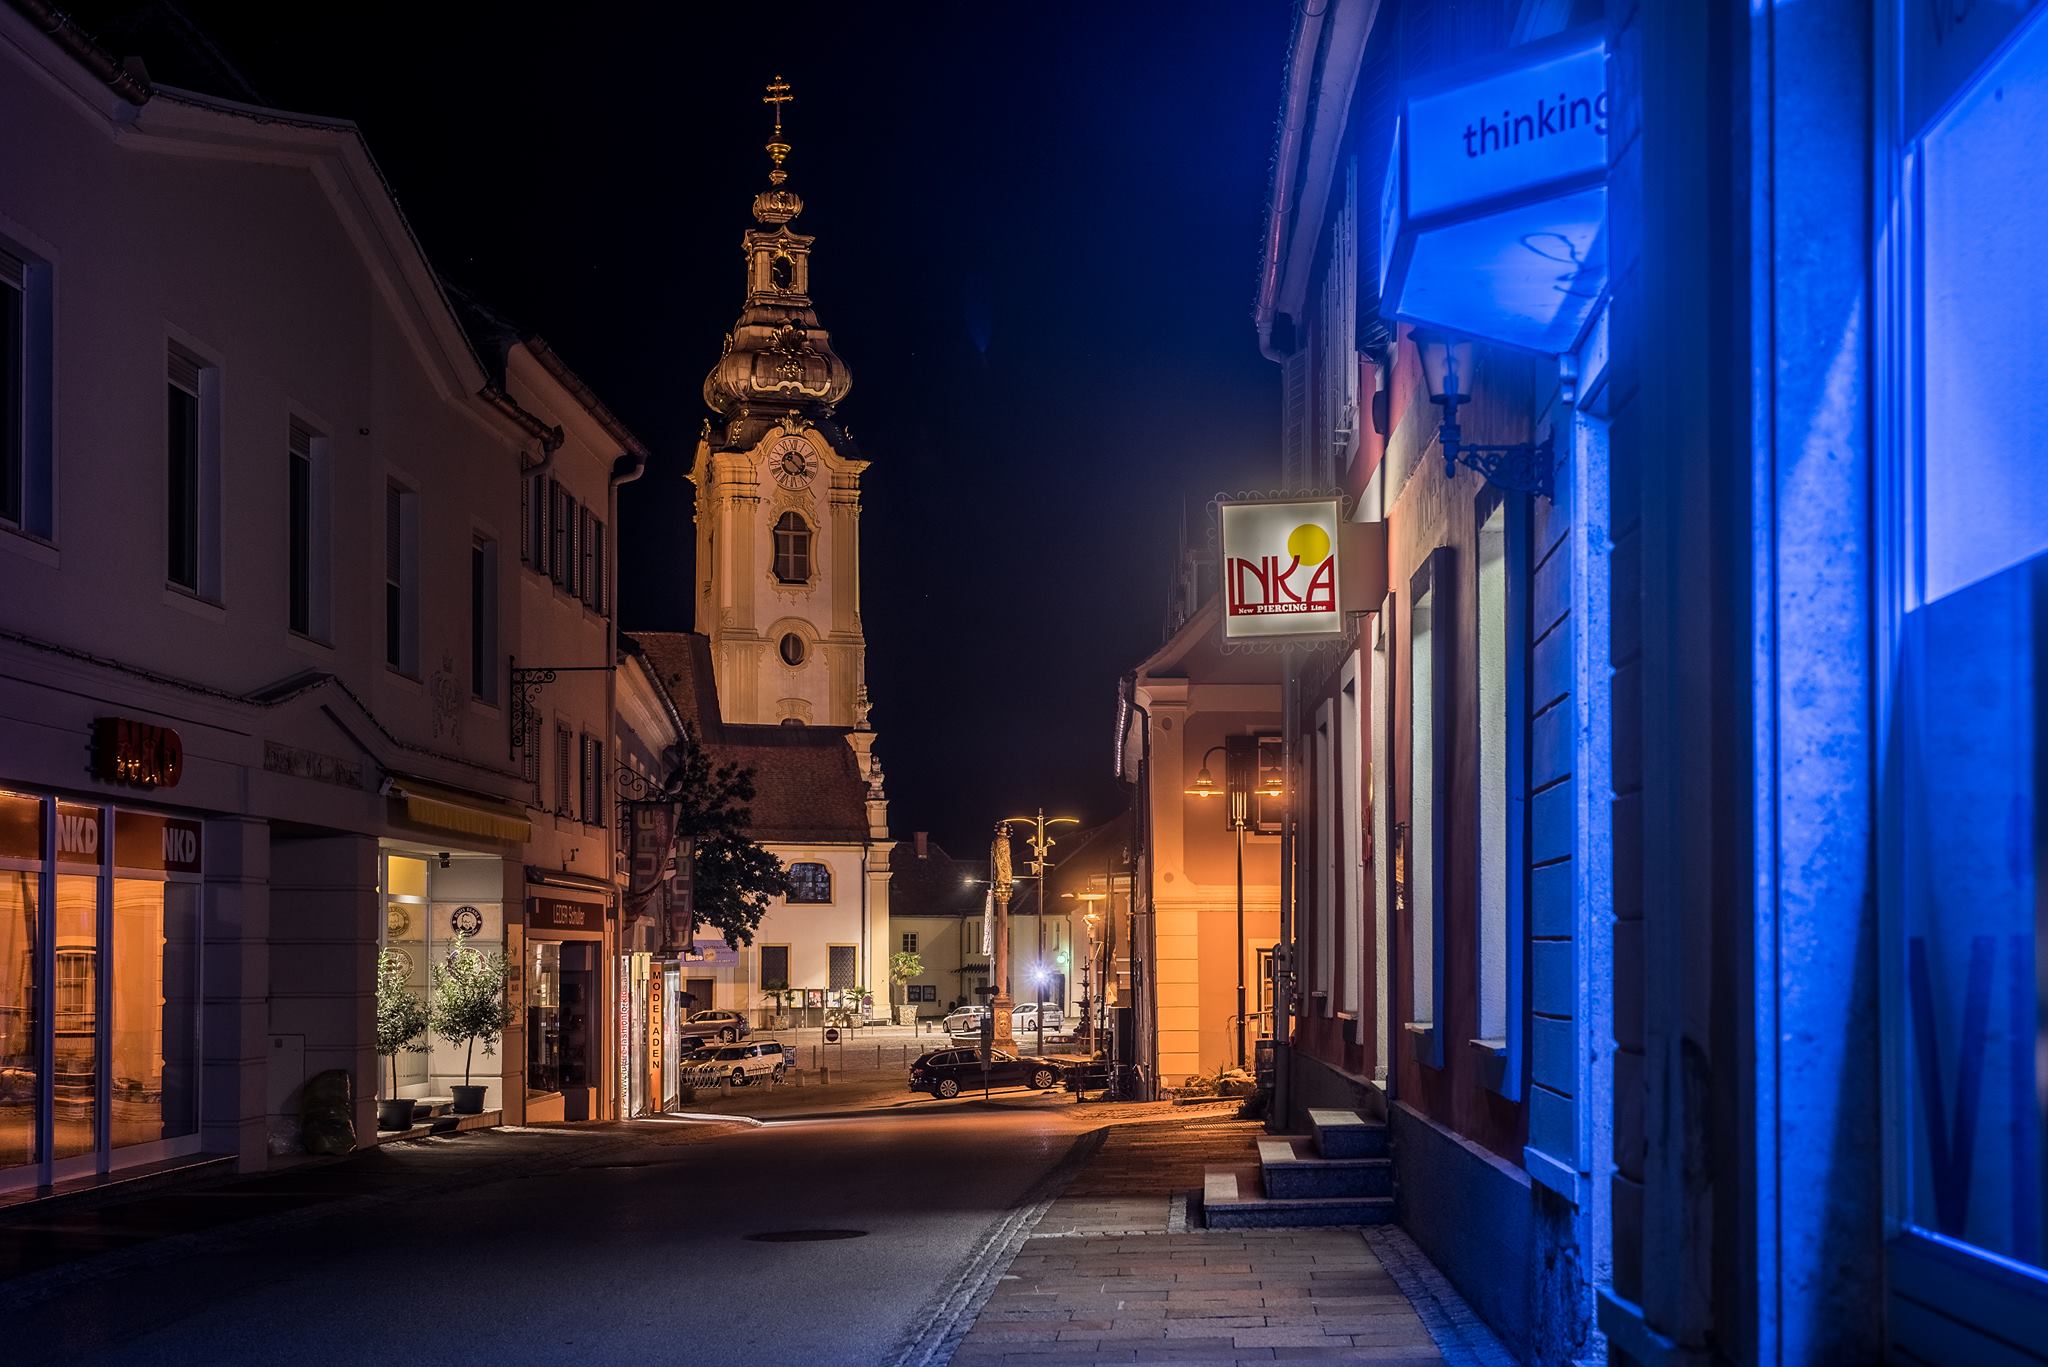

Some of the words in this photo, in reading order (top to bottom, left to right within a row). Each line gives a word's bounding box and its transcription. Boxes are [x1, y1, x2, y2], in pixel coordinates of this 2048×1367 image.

[1462, 91, 1608, 158] thinking
[1227, 554, 1335, 605] INKA
[1257, 603, 1307, 613] PIERCING
[116, 718, 183, 787] NKD
[57, 814, 98, 854] NKD
[162, 827, 196, 863] NKD
[552, 904, 567, 924] LEDER
[652, 971, 661, 1069] MODELADEN
